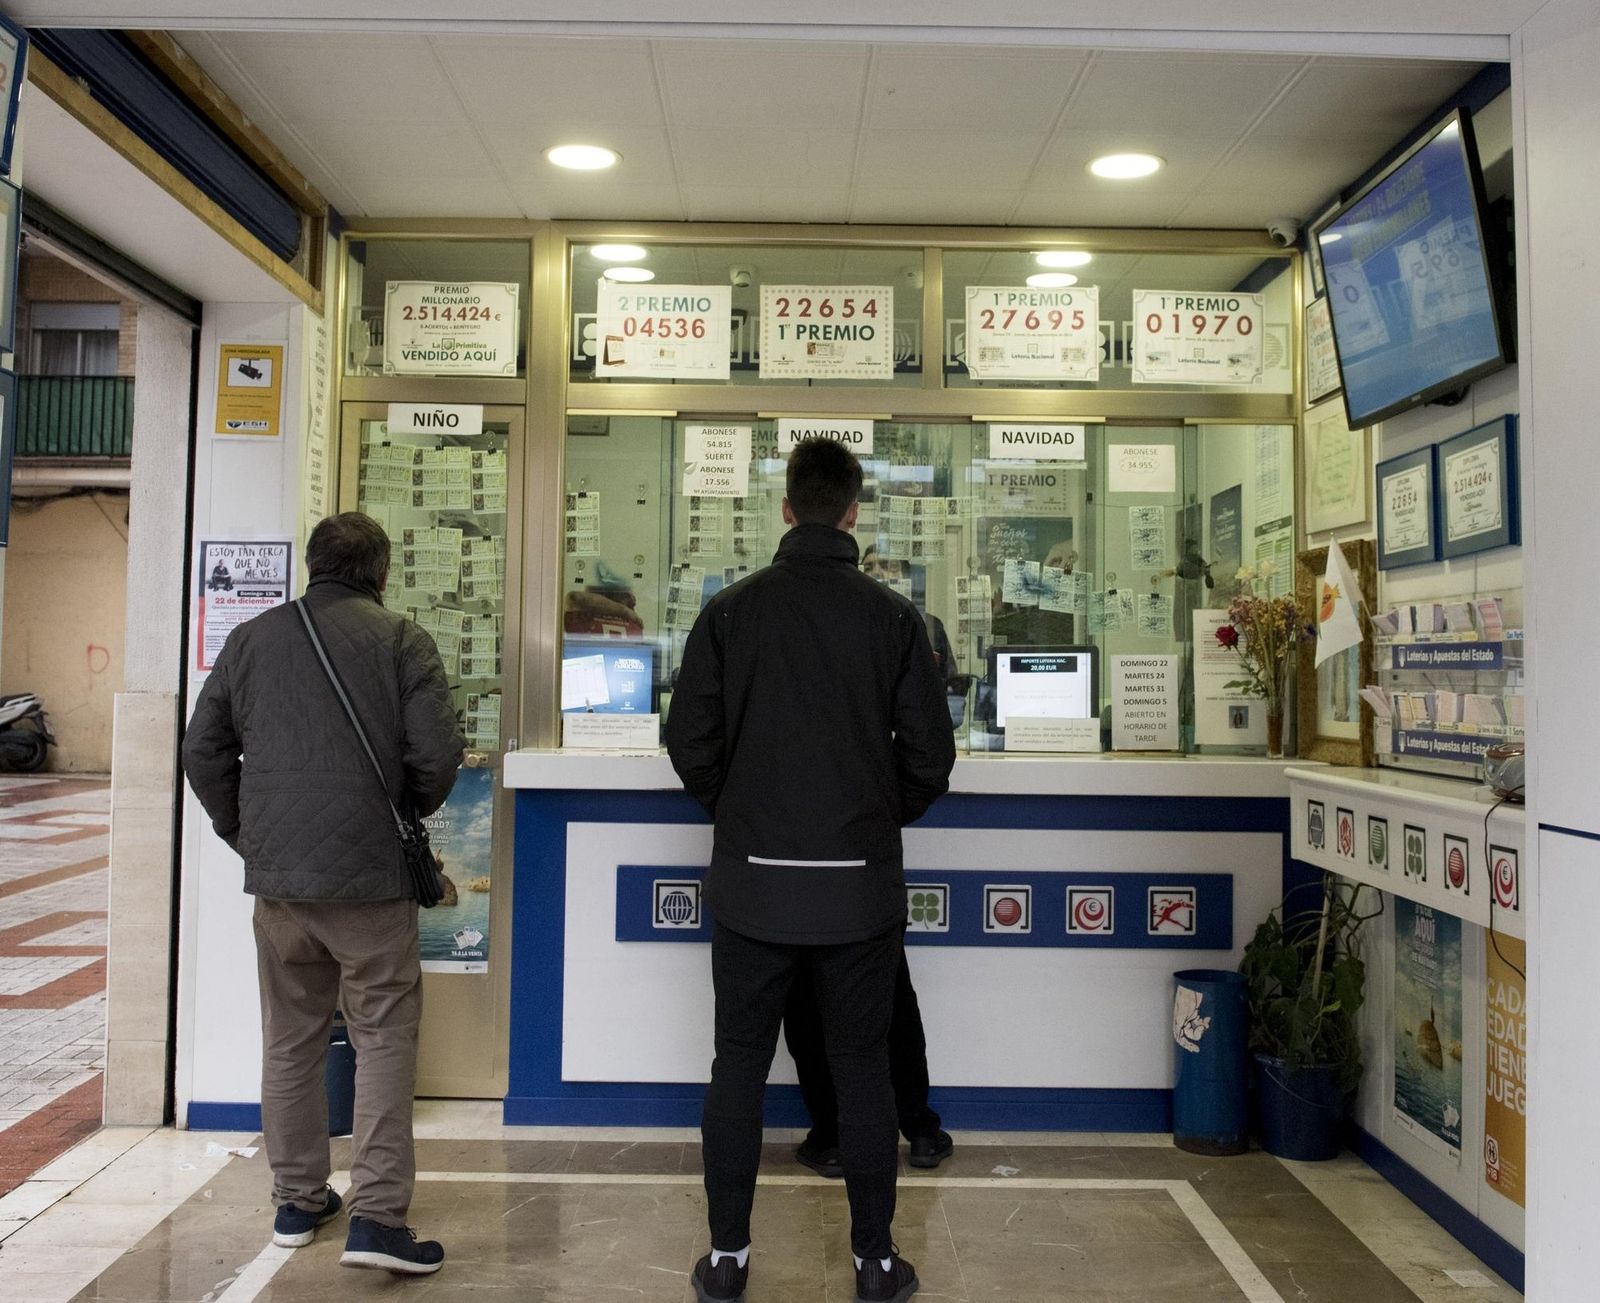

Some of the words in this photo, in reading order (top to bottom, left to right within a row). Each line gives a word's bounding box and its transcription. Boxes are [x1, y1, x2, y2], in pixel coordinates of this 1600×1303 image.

[434, 286, 470, 294] PREMIO
[421, 296, 480, 305] MILLONARIO
[636, 296, 711, 312] PREMIO
[1008, 293, 1073, 306] PREMIO
[1175, 297, 1240, 312] PREMIO
[402, 306, 490, 321] 2.514.424
[494, 313, 502, 321] €
[776, 298, 878, 318] 22654
[980, 309, 1084, 330] 27695
[1146, 314, 1253, 336] 01970
[624, 316, 706, 338] 04536
[796, 324, 874, 341] PREMIO
[402, 350, 459, 361] VENDIDO
[464, 348, 496, 362] AQUÍ
[413, 410, 459, 428] NIÑO
[790, 430, 863, 444] NAVIDAD
[1002, 432, 1074, 445] NAVIDAD
[1001, 474, 1056, 487] PREMIO
[209, 547, 235, 558] ESTOY
[238, 547, 255, 557] TAN
[259, 547, 284, 558] CERCA
[235, 559, 252, 569] QUE
[256, 558, 270, 568] NO
[244, 569, 257, 578] ME
[261, 568, 278, 578] VES
[1429, 653, 1433, 664] y
[1434, 650, 1460, 664] Apuestas
[1461, 649, 1471, 661] del
[1472, 649, 1494, 661] Estado
[1429, 740, 1433, 752] y
[1434, 739, 1460, 753] Apuestas
[1461, 741, 1471, 753] del
